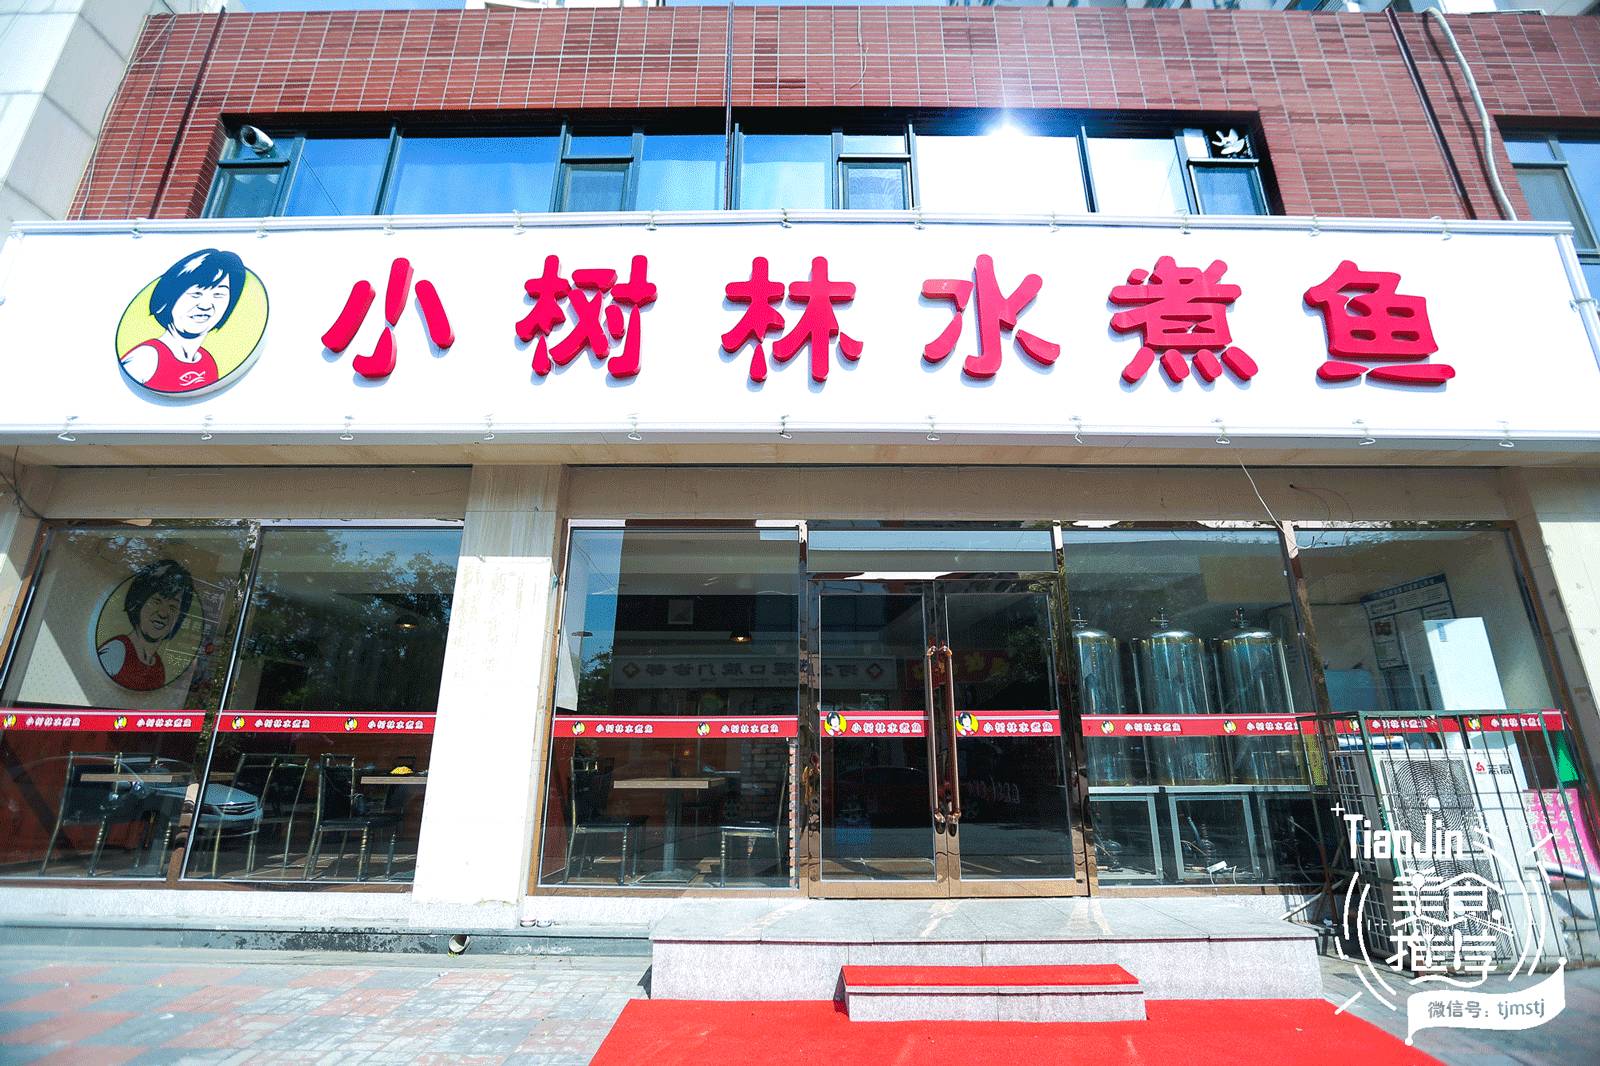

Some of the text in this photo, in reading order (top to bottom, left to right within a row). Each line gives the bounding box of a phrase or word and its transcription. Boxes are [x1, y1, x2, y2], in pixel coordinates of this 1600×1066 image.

[321, 254, 1456, 386] 小树林水煮鱼
[25, 716, 81, 727] 小树林水煮鱼
[136, 718, 192, 728] 小树林水煮鱼
[254, 719, 311, 728] 小树林水煮鱼
[367, 720, 424, 729] 小树林水煮鱼
[1124, 721, 1182, 732] 小树林水煮鱼
[595, 723, 654, 733] 小树林水煮鱼
[720, 723, 779, 733] 小树林水煮鱼
[850, 721, 923, 734] 小树林水煮鱼
[982, 721, 1054, 734] 小树林水煮鱼
